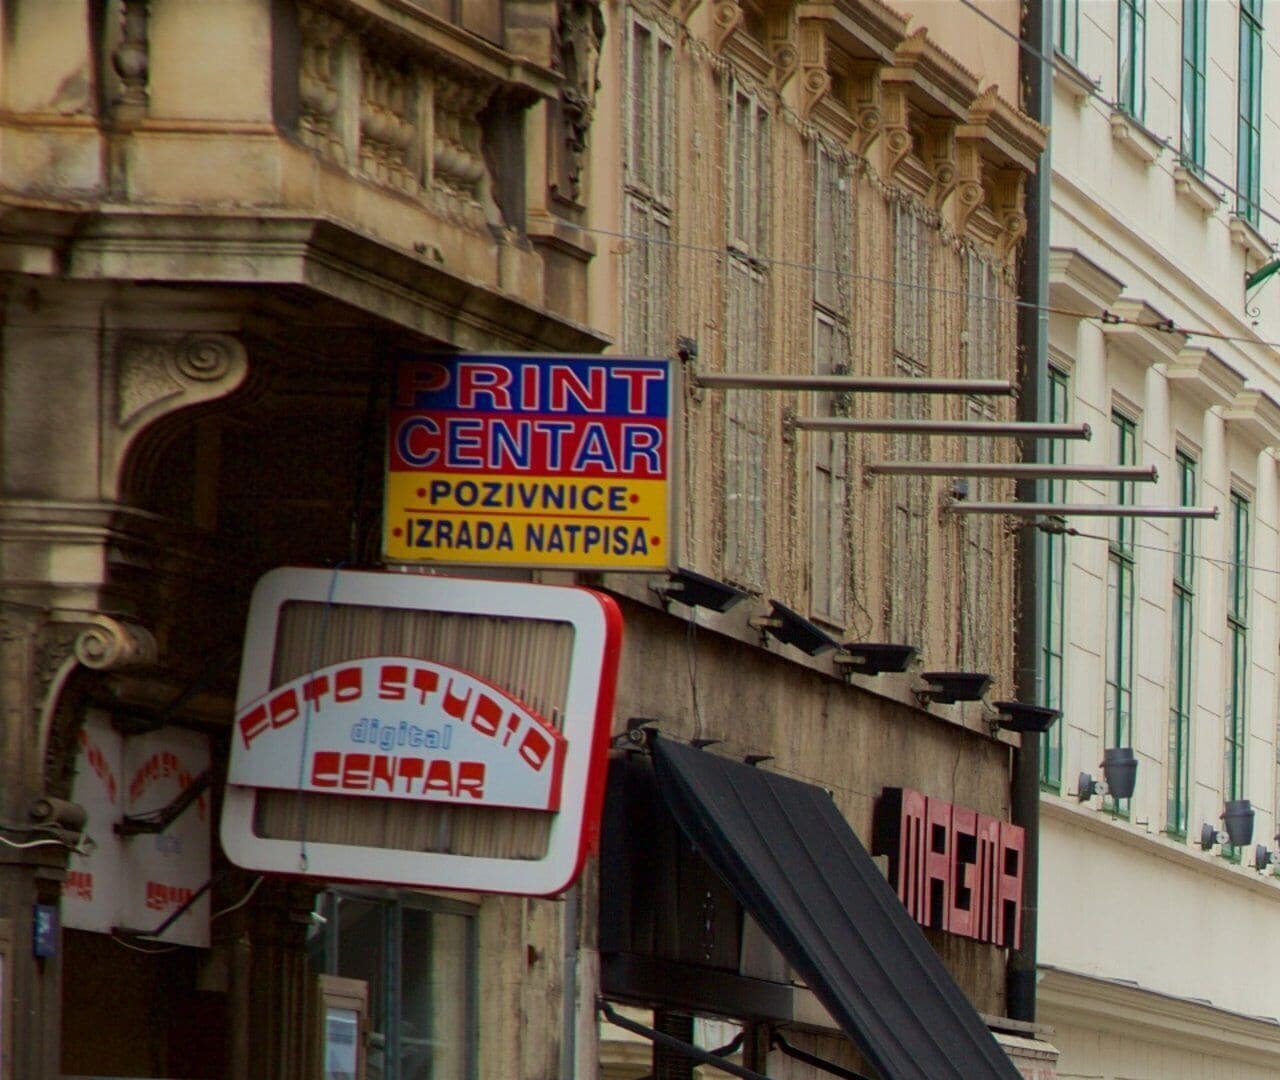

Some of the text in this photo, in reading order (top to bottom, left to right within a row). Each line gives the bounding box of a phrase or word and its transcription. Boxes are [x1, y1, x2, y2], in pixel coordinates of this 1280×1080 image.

[398, 361, 664, 415] PRINT
[396, 415, 662, 474] CENTAR
[429, 480, 628, 511] POZIVNICE
[406, 518, 648, 556] IZRADA NATPISA
[238, 666, 363, 750] FOTO
[351, 717, 453, 751] digital
[312, 751, 486, 800] CENTAR
[898, 787, 1026, 951] MAGMA
